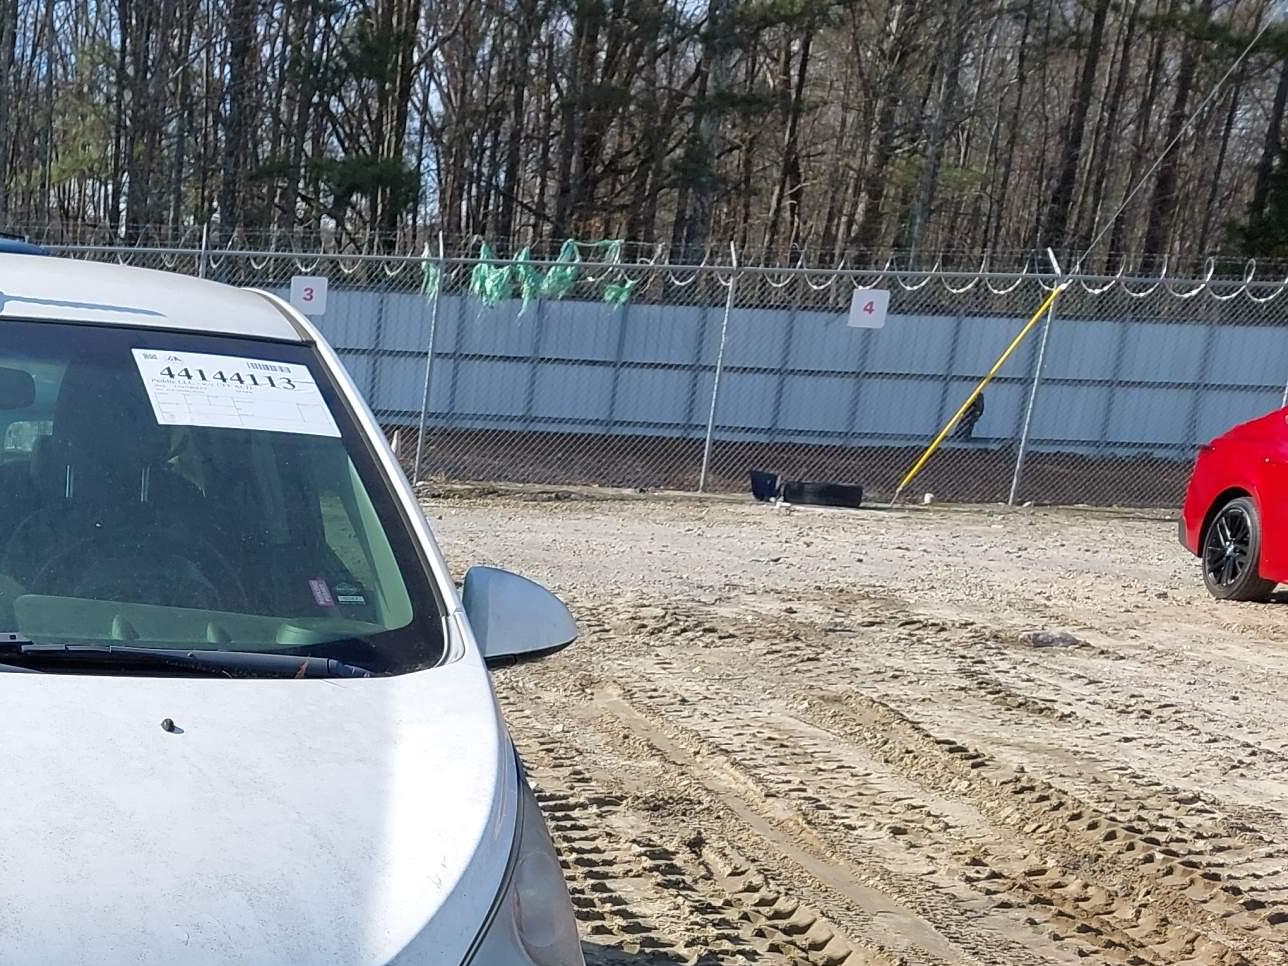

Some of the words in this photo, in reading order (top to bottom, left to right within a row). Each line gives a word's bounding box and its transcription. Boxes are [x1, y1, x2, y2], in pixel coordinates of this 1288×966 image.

[303, 287, 314, 301] 3
[863, 301, 874, 314] 4
[159, 365, 297, 391] 44144113
